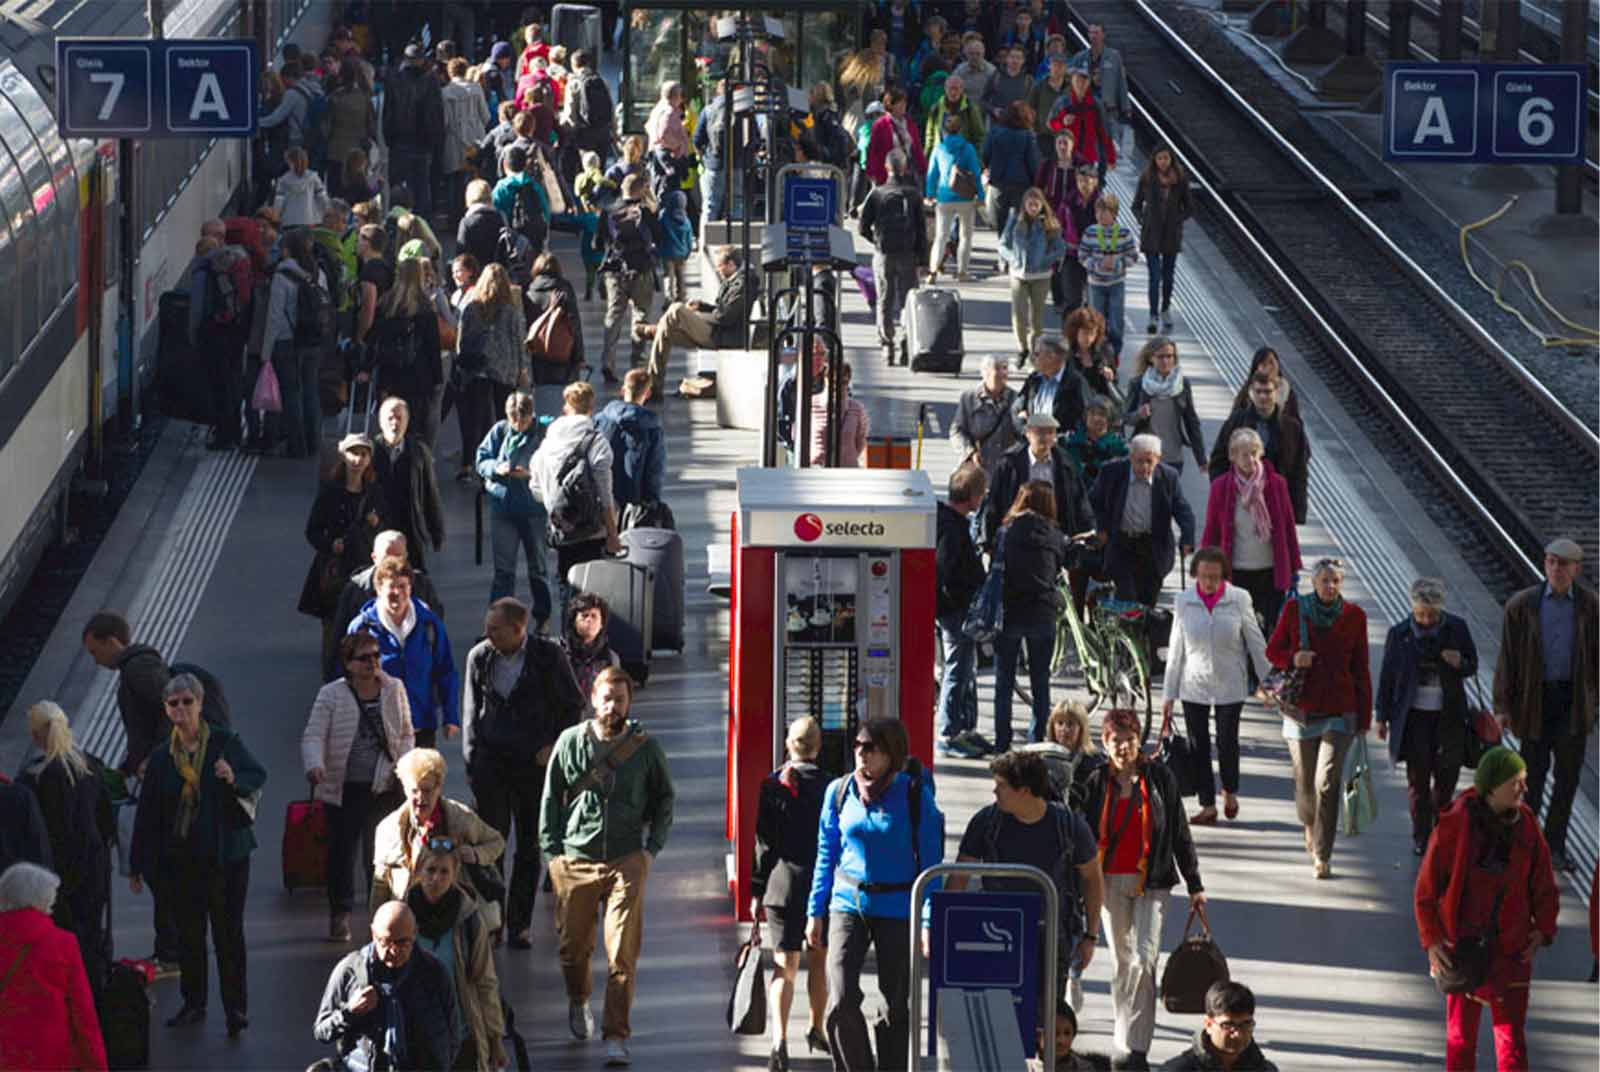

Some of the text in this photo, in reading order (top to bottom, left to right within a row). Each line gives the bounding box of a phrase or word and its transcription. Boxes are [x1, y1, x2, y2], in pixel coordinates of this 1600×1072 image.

[90, 72, 125, 121] 7
[189, 72, 231, 121] A
[1412, 95, 1455, 145] A
[1517, 96, 1555, 146] 6
[825, 521, 885, 537] selecta
